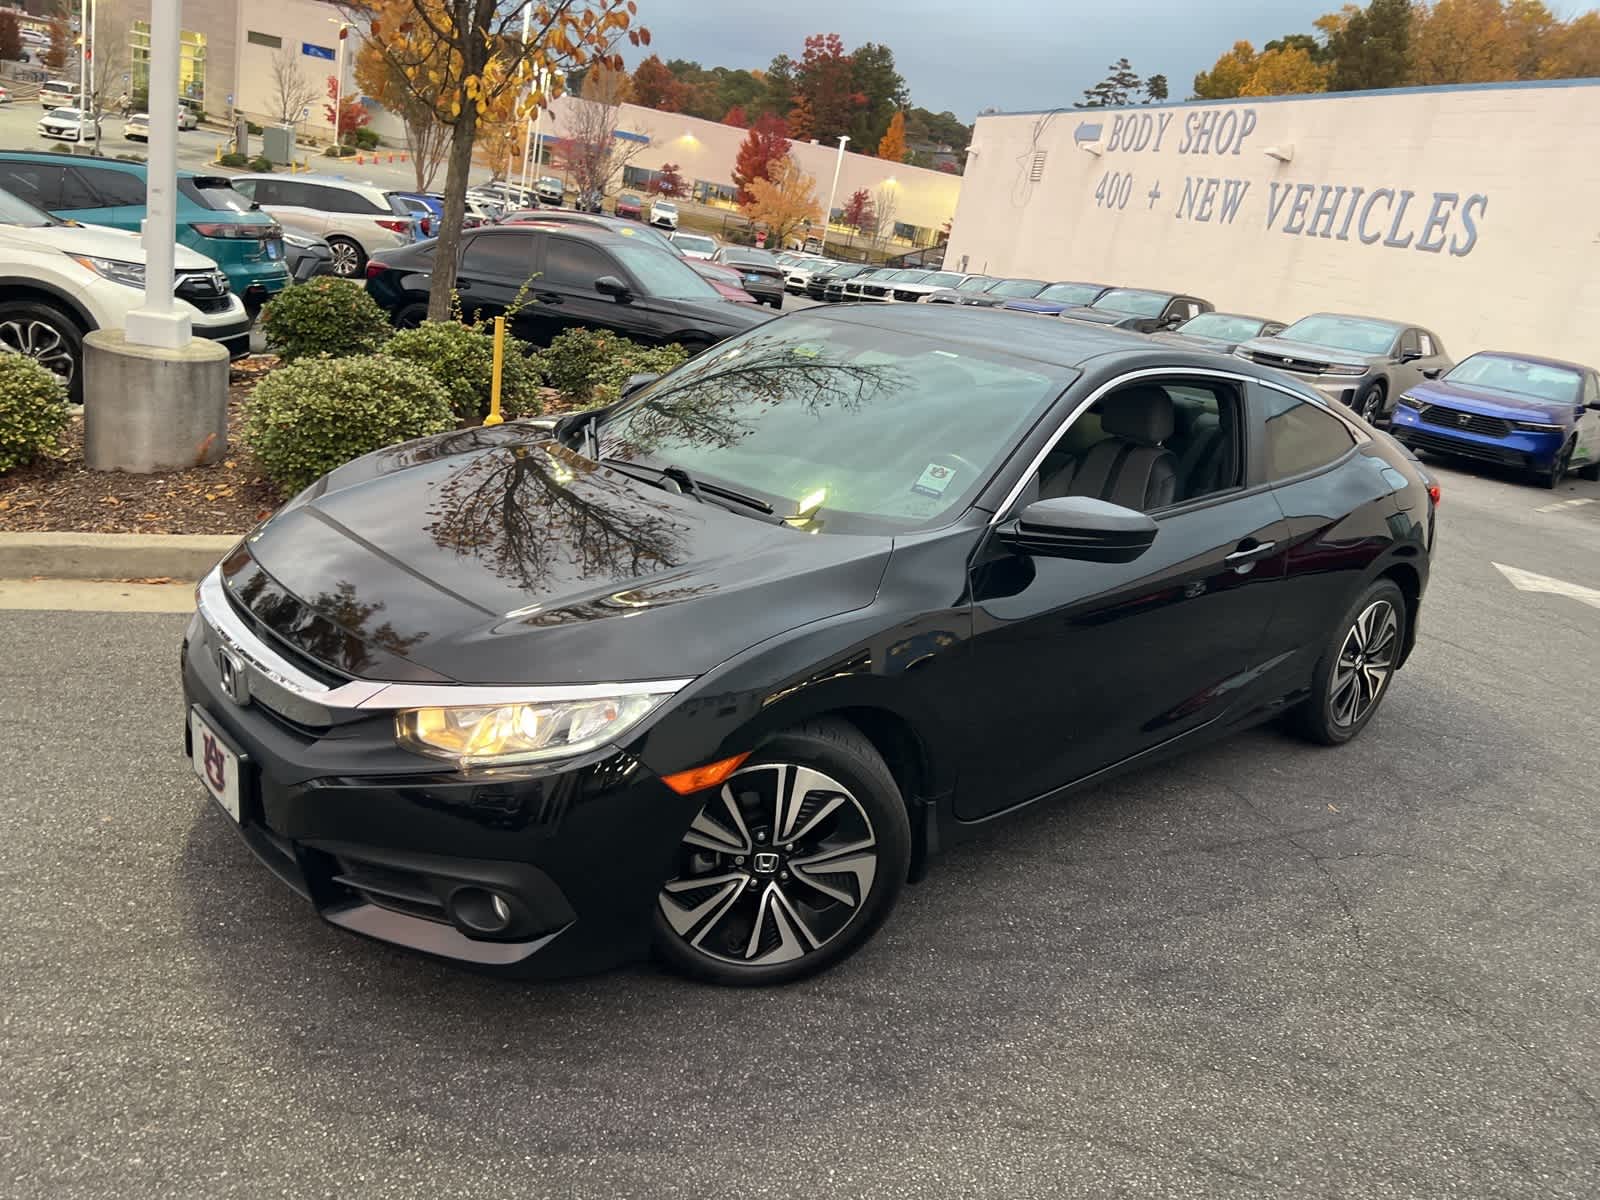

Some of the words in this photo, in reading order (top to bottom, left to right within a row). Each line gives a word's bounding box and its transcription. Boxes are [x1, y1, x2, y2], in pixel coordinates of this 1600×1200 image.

[1106, 112, 1174, 152] BODY
[1178, 109, 1257, 155] SHOP
[1095, 170, 1133, 210] 400
[1175, 176, 1251, 224] NEW
[1266, 181, 1489, 257] VEHICLES
